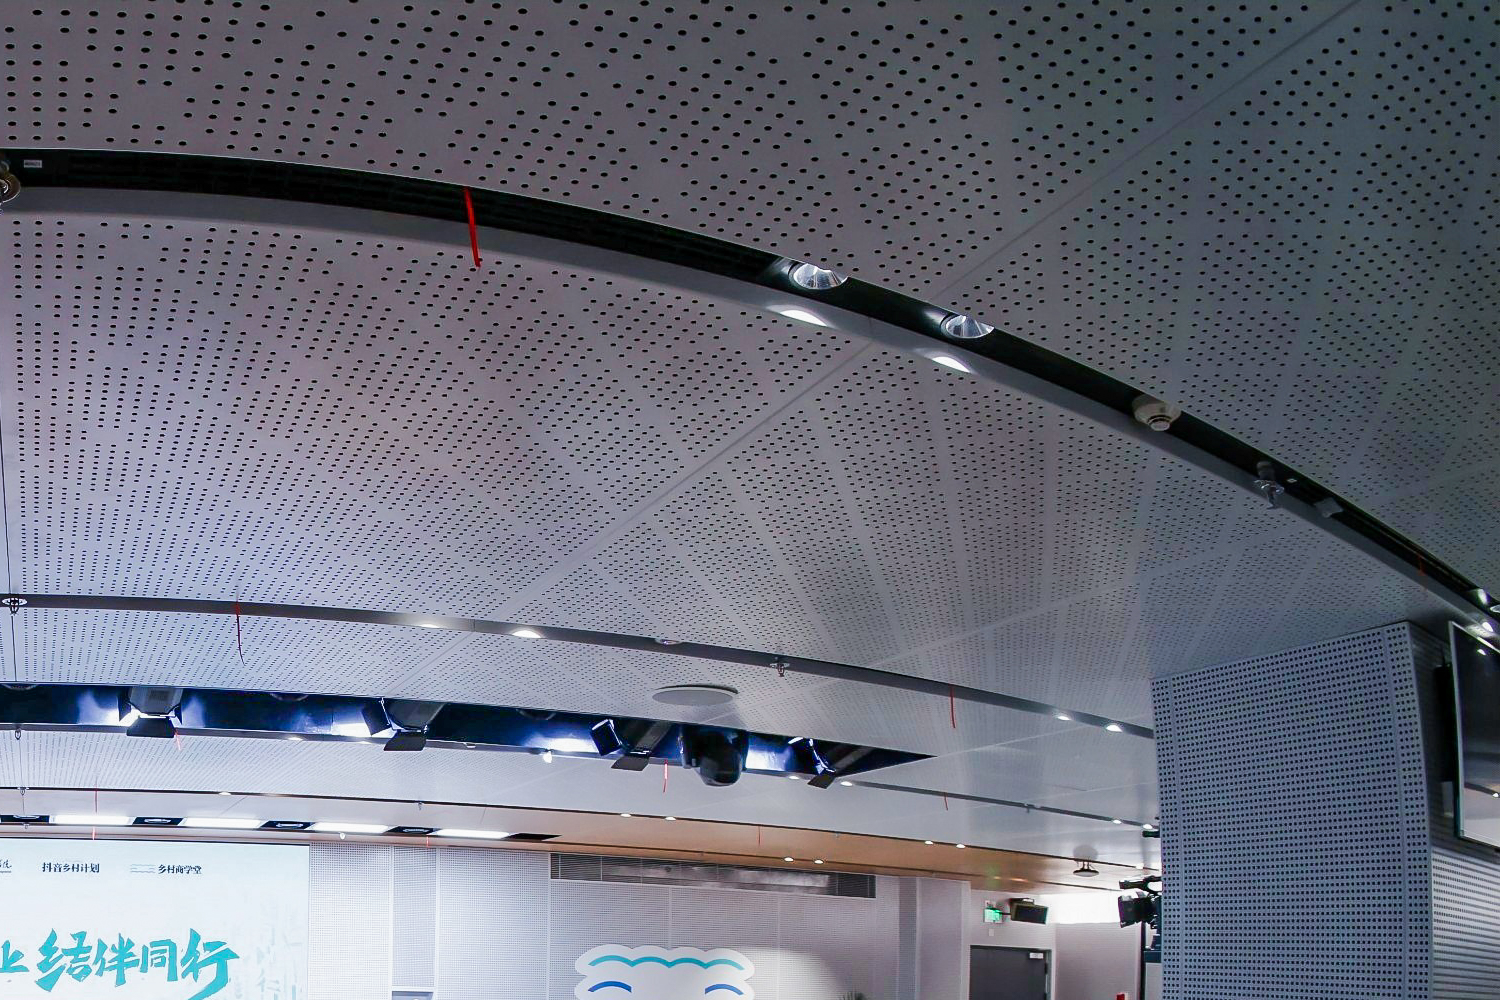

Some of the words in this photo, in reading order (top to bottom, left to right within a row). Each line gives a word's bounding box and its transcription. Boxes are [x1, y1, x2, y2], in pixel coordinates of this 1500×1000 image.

[42, 862, 100, 873] 抖音乡村计划
[158, 864, 202, 875] 乡村商学堂
